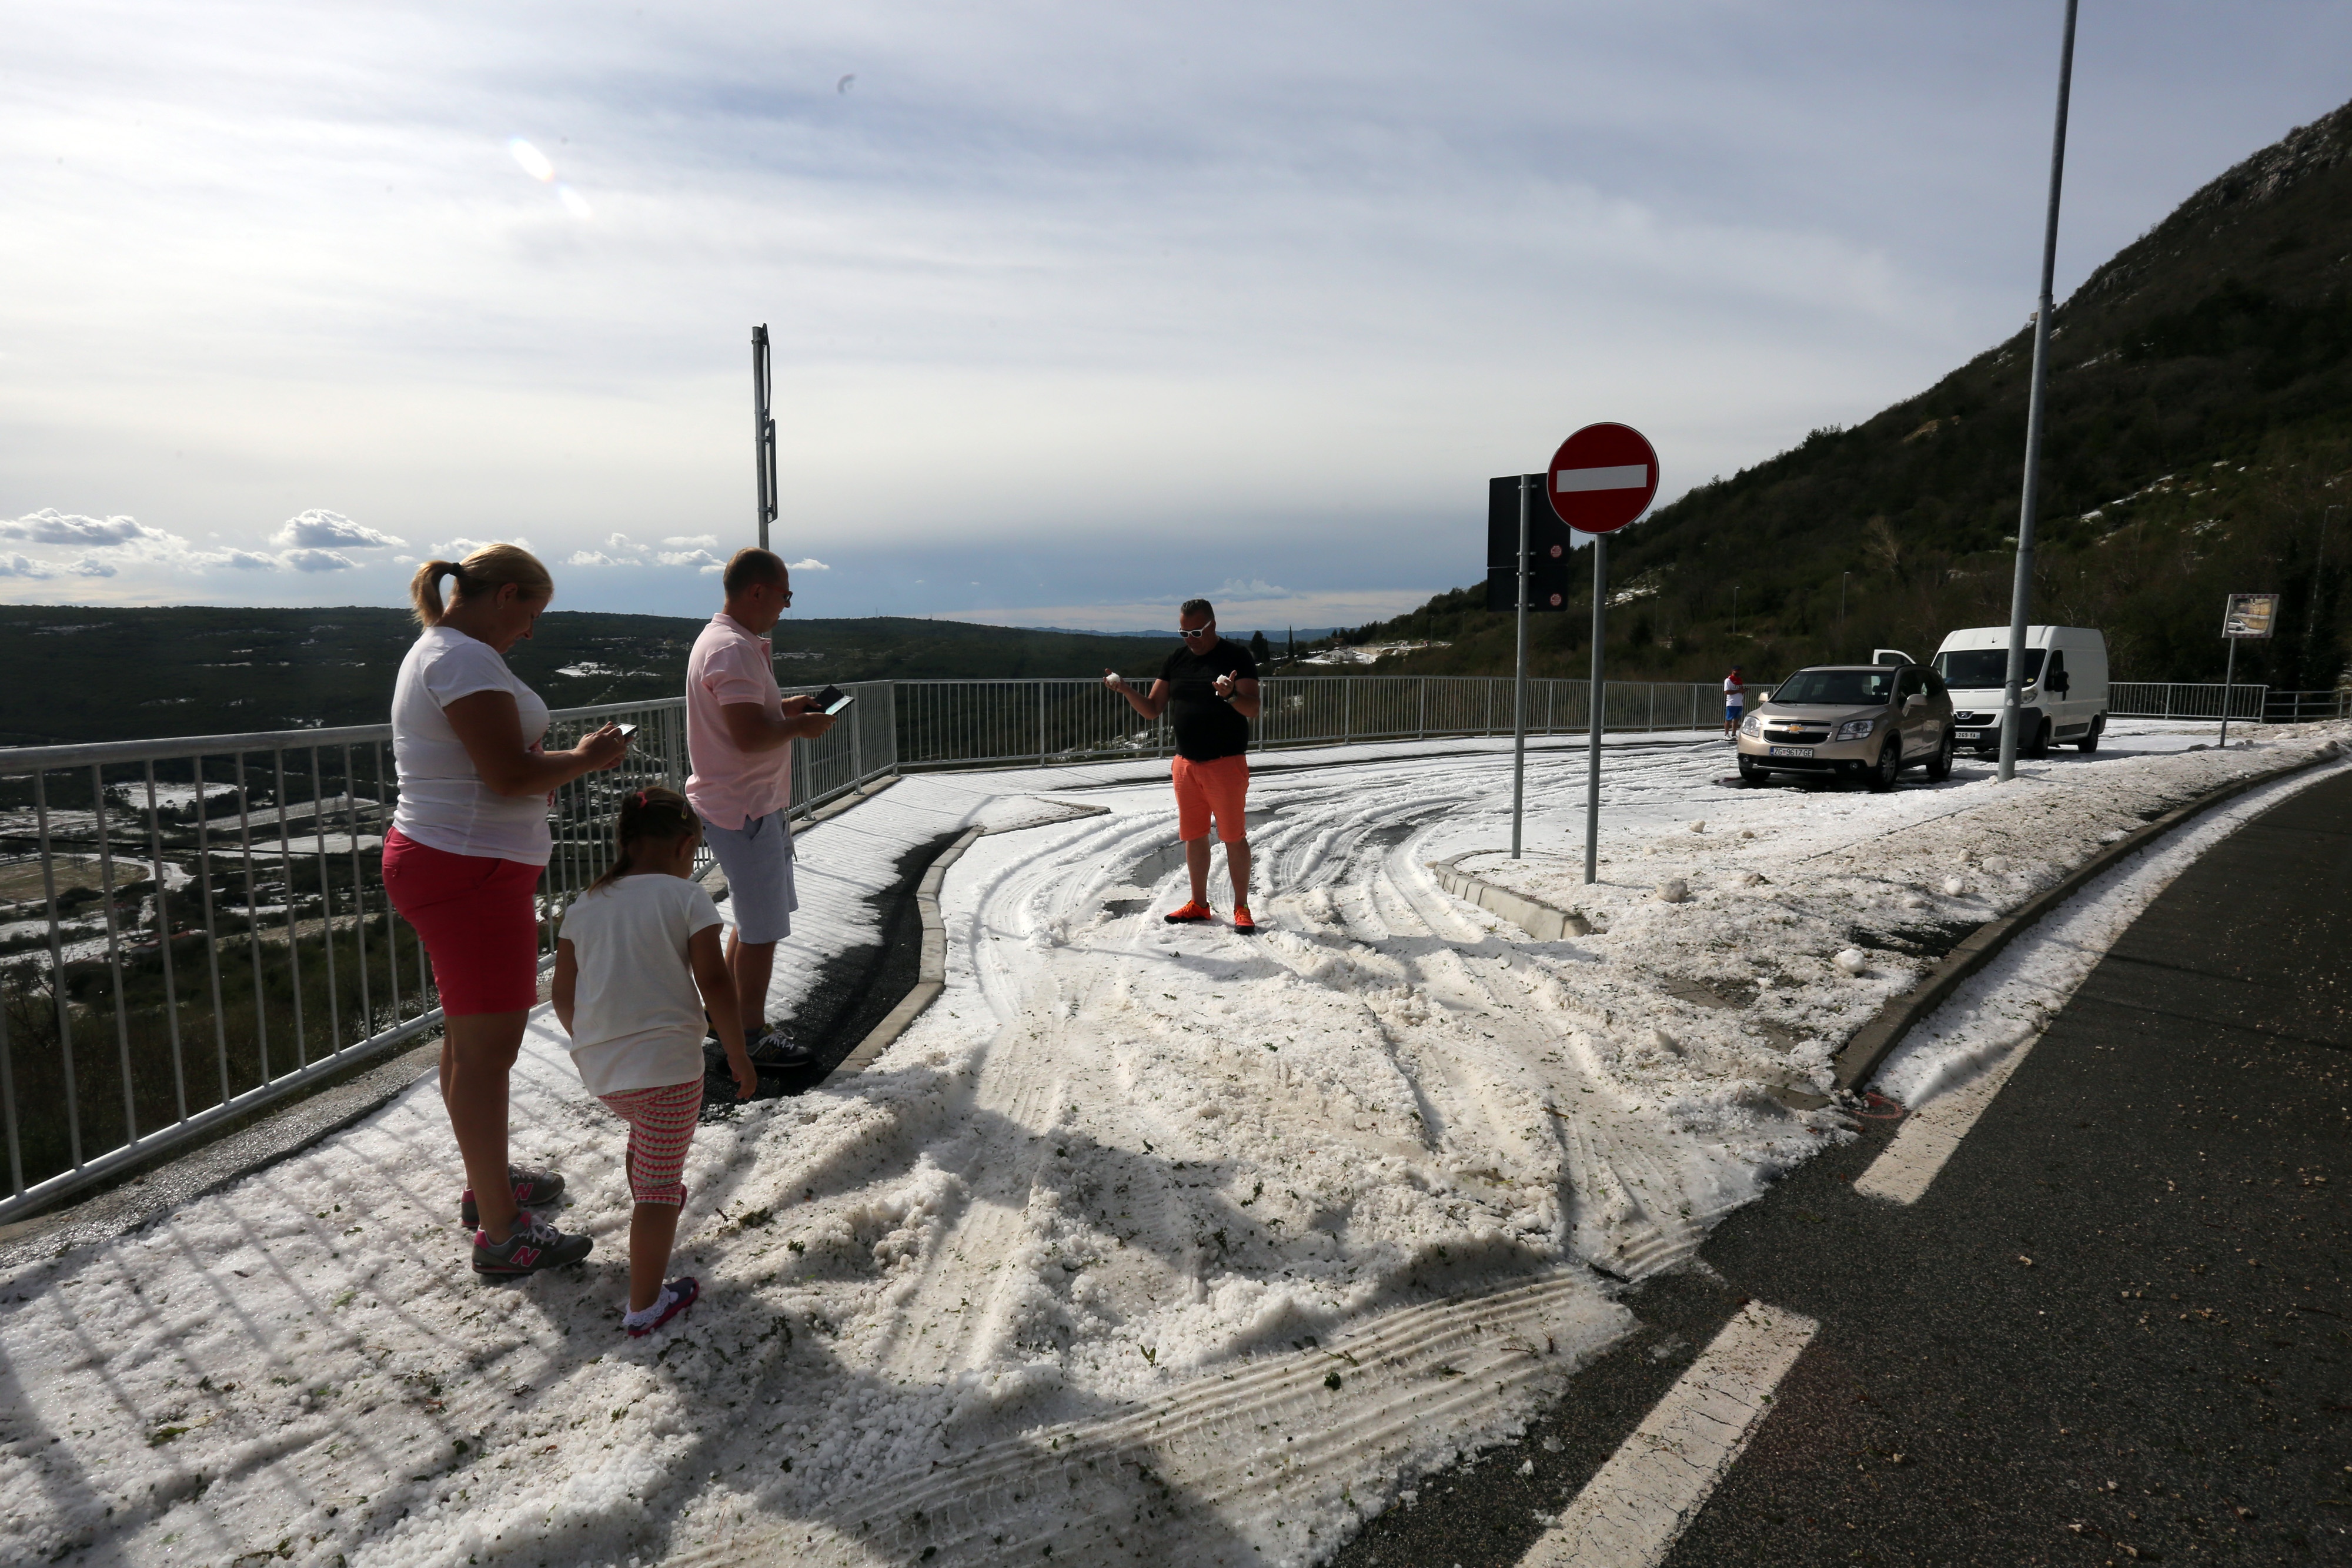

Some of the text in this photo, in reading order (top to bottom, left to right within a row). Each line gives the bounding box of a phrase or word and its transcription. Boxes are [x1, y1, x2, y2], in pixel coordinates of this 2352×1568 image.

[757, 1045, 780, 1062] N
[513, 1182, 534, 1201] N
[509, 1245, 542, 1268] N
